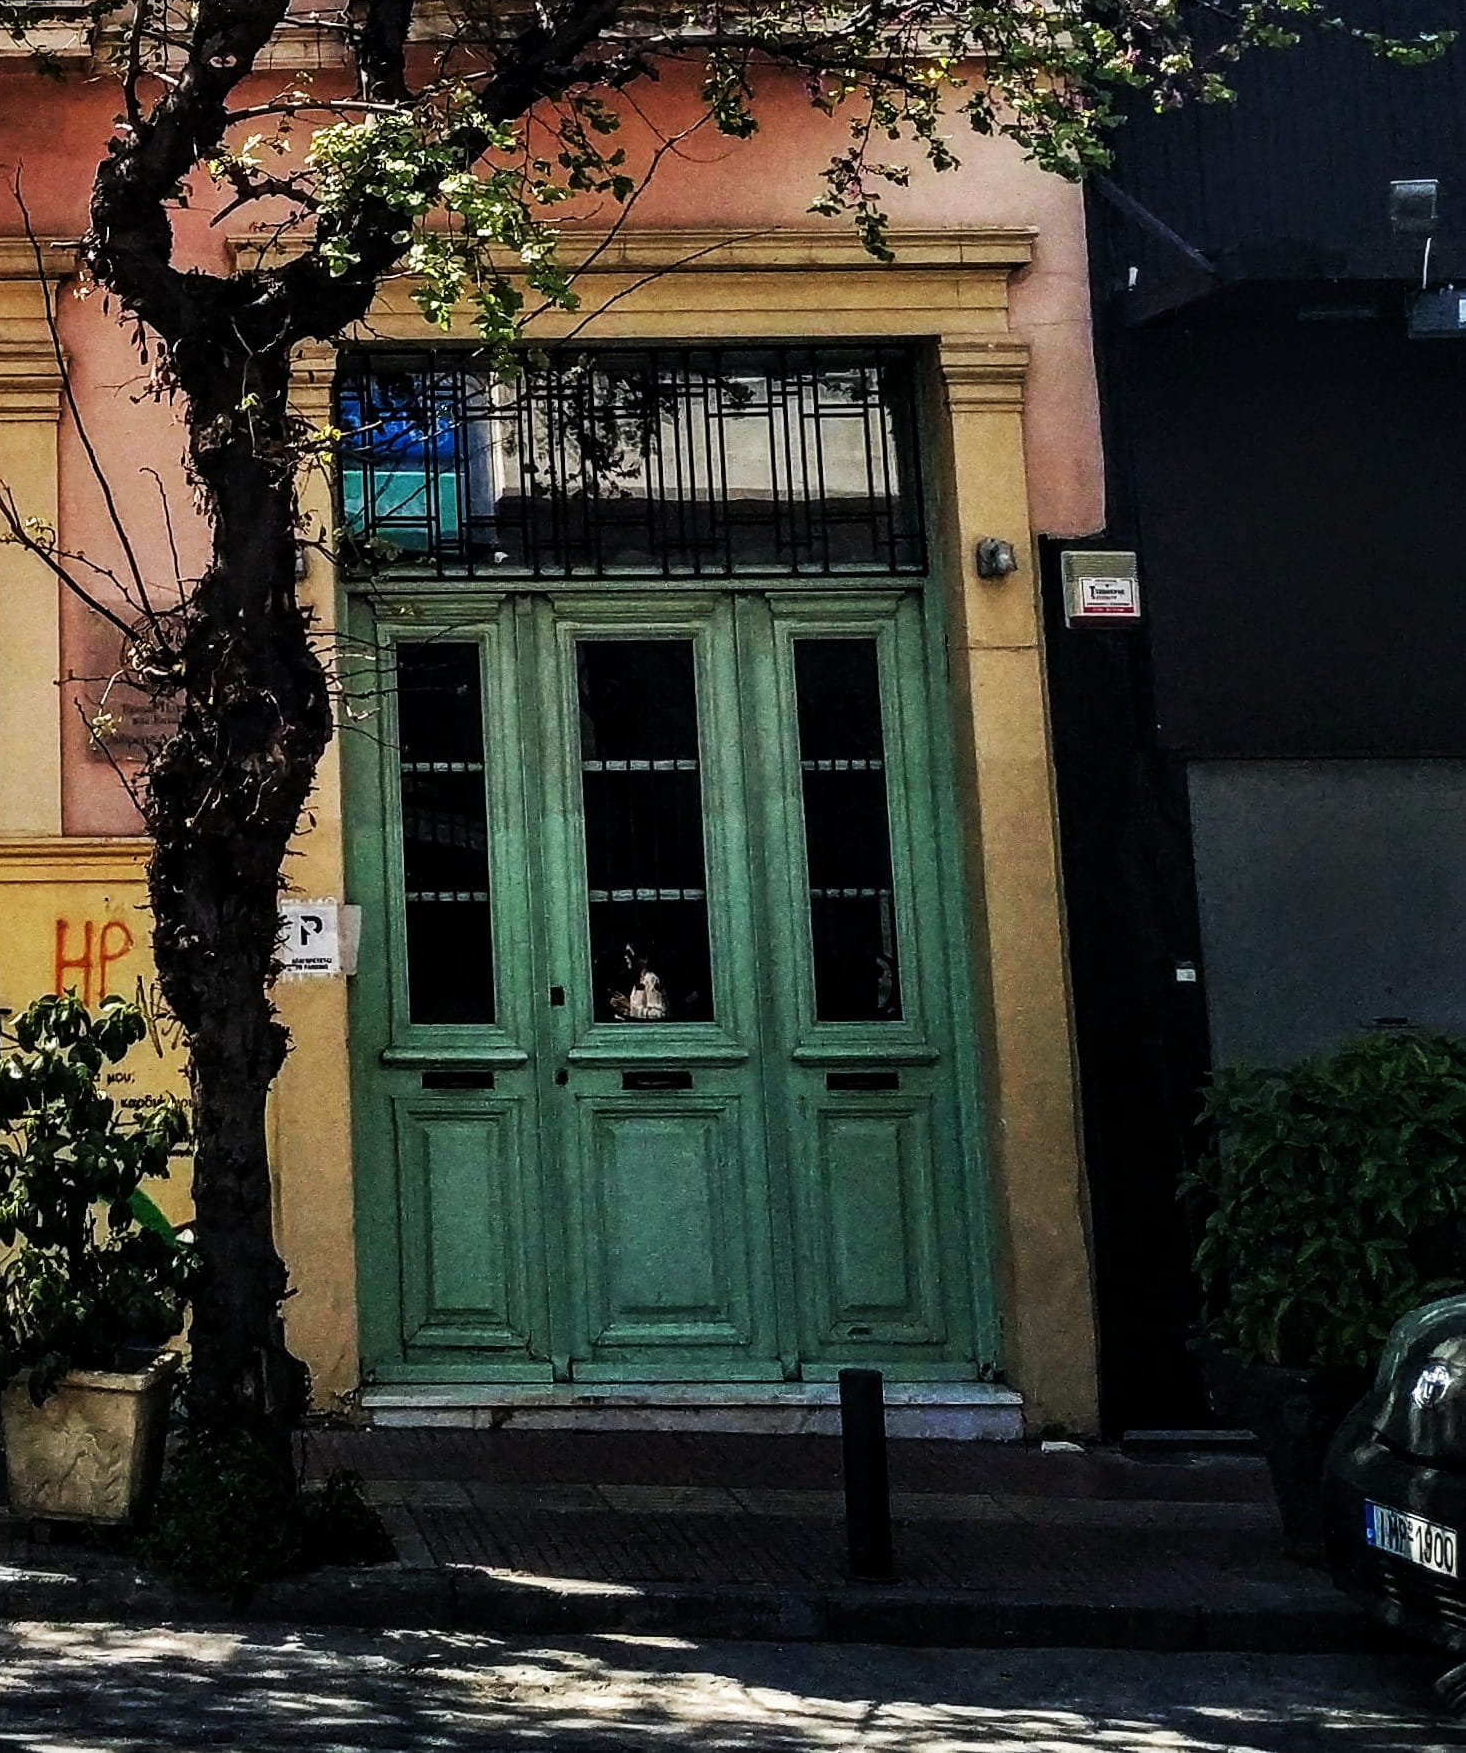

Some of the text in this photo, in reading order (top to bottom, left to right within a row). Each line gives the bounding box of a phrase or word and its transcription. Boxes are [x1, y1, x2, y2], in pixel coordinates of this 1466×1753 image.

[300, 915, 323, 946] P
[55, 919, 134, 1008] HP
[107, 1072, 135, 1085] μου,
